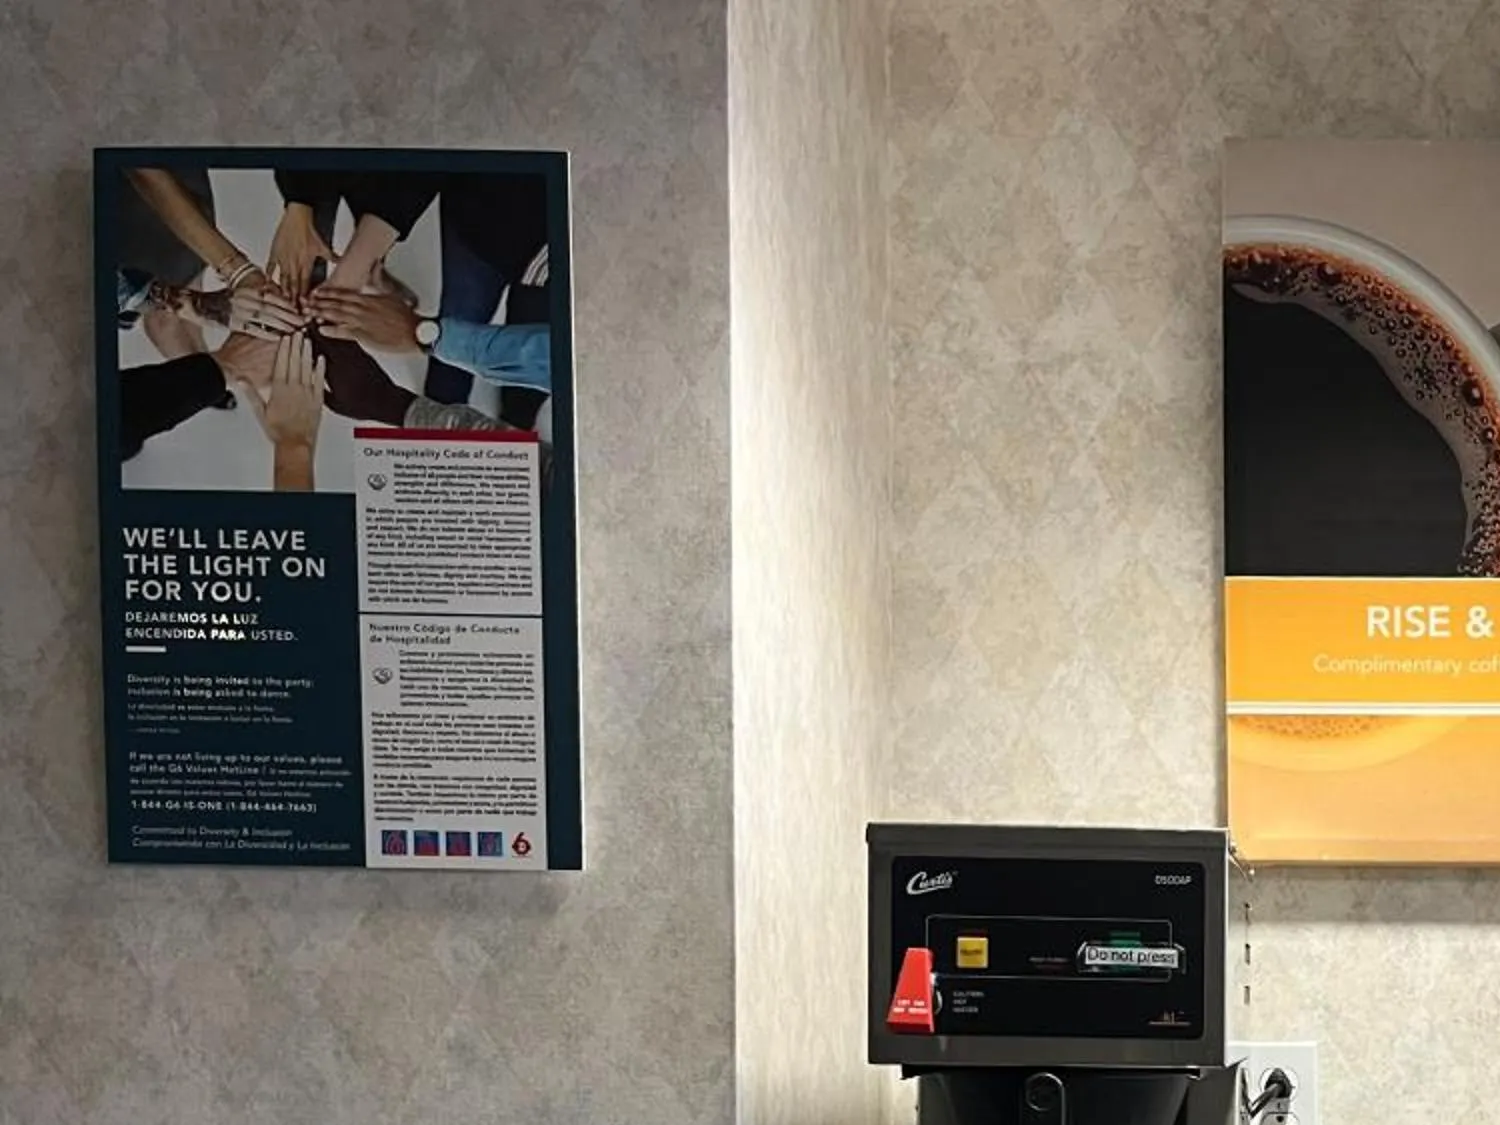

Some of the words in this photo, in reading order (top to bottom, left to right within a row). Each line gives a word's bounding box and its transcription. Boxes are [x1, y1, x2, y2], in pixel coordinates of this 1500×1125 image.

[363, 447, 382, 457] Our
[386, 448, 440, 460] Hospitality
[444, 450, 470, 459] Code
[474, 450, 482, 459] of
[486, 450, 529, 460] Conduct
[122, 527, 207, 549] WE'LL
[219, 529, 306, 551] LEAVE
[123, 554, 177, 575] THE
[189, 555, 271, 576] LIGHT
[281, 557, 325, 577] ON
[125, 579, 181, 601] FOR
[192, 581, 261, 603] YOU.
[125, 611, 207, 624] DEJAREMOS
[211, 613, 229, 625] LA
[233, 614, 259, 625] LUZ
[1366, 606, 1450, 638] RISE
[1465, 605, 1494, 638] &
[125, 627, 207, 640] ENCENDIDA
[211, 629, 246, 641] PARA
[251, 630, 299, 641] USTED.
[369, 623, 410, 633] Nuestro
[455, 625, 467, 633] de
[369, 636, 382, 644] de
[386, 636, 451, 646] Hospitalidad
[1313, 654, 1462, 678] Complimentary
[128, 673, 170, 686] Diversity
[184, 674, 213, 687] being
[216, 675, 249, 685] invited
[253, 677, 263, 685] to
[266, 675, 282, 686] the
[184, 687, 213, 699] being
[215, 687, 244, 697] asked
[247, 688, 257, 697] to
[176, 752, 192, 760] not
[224, 755, 237, 764] up
[129, 763, 146, 772] call
[149, 763, 165, 773] the
[168, 763, 182, 773] G6
[186, 763, 217, 773] Values
[906, 871, 953, 895] Curtis
[1087, 948, 1107, 961] Do
[1111, 949, 1134, 962] not
[1137, 951, 1175, 965] press
